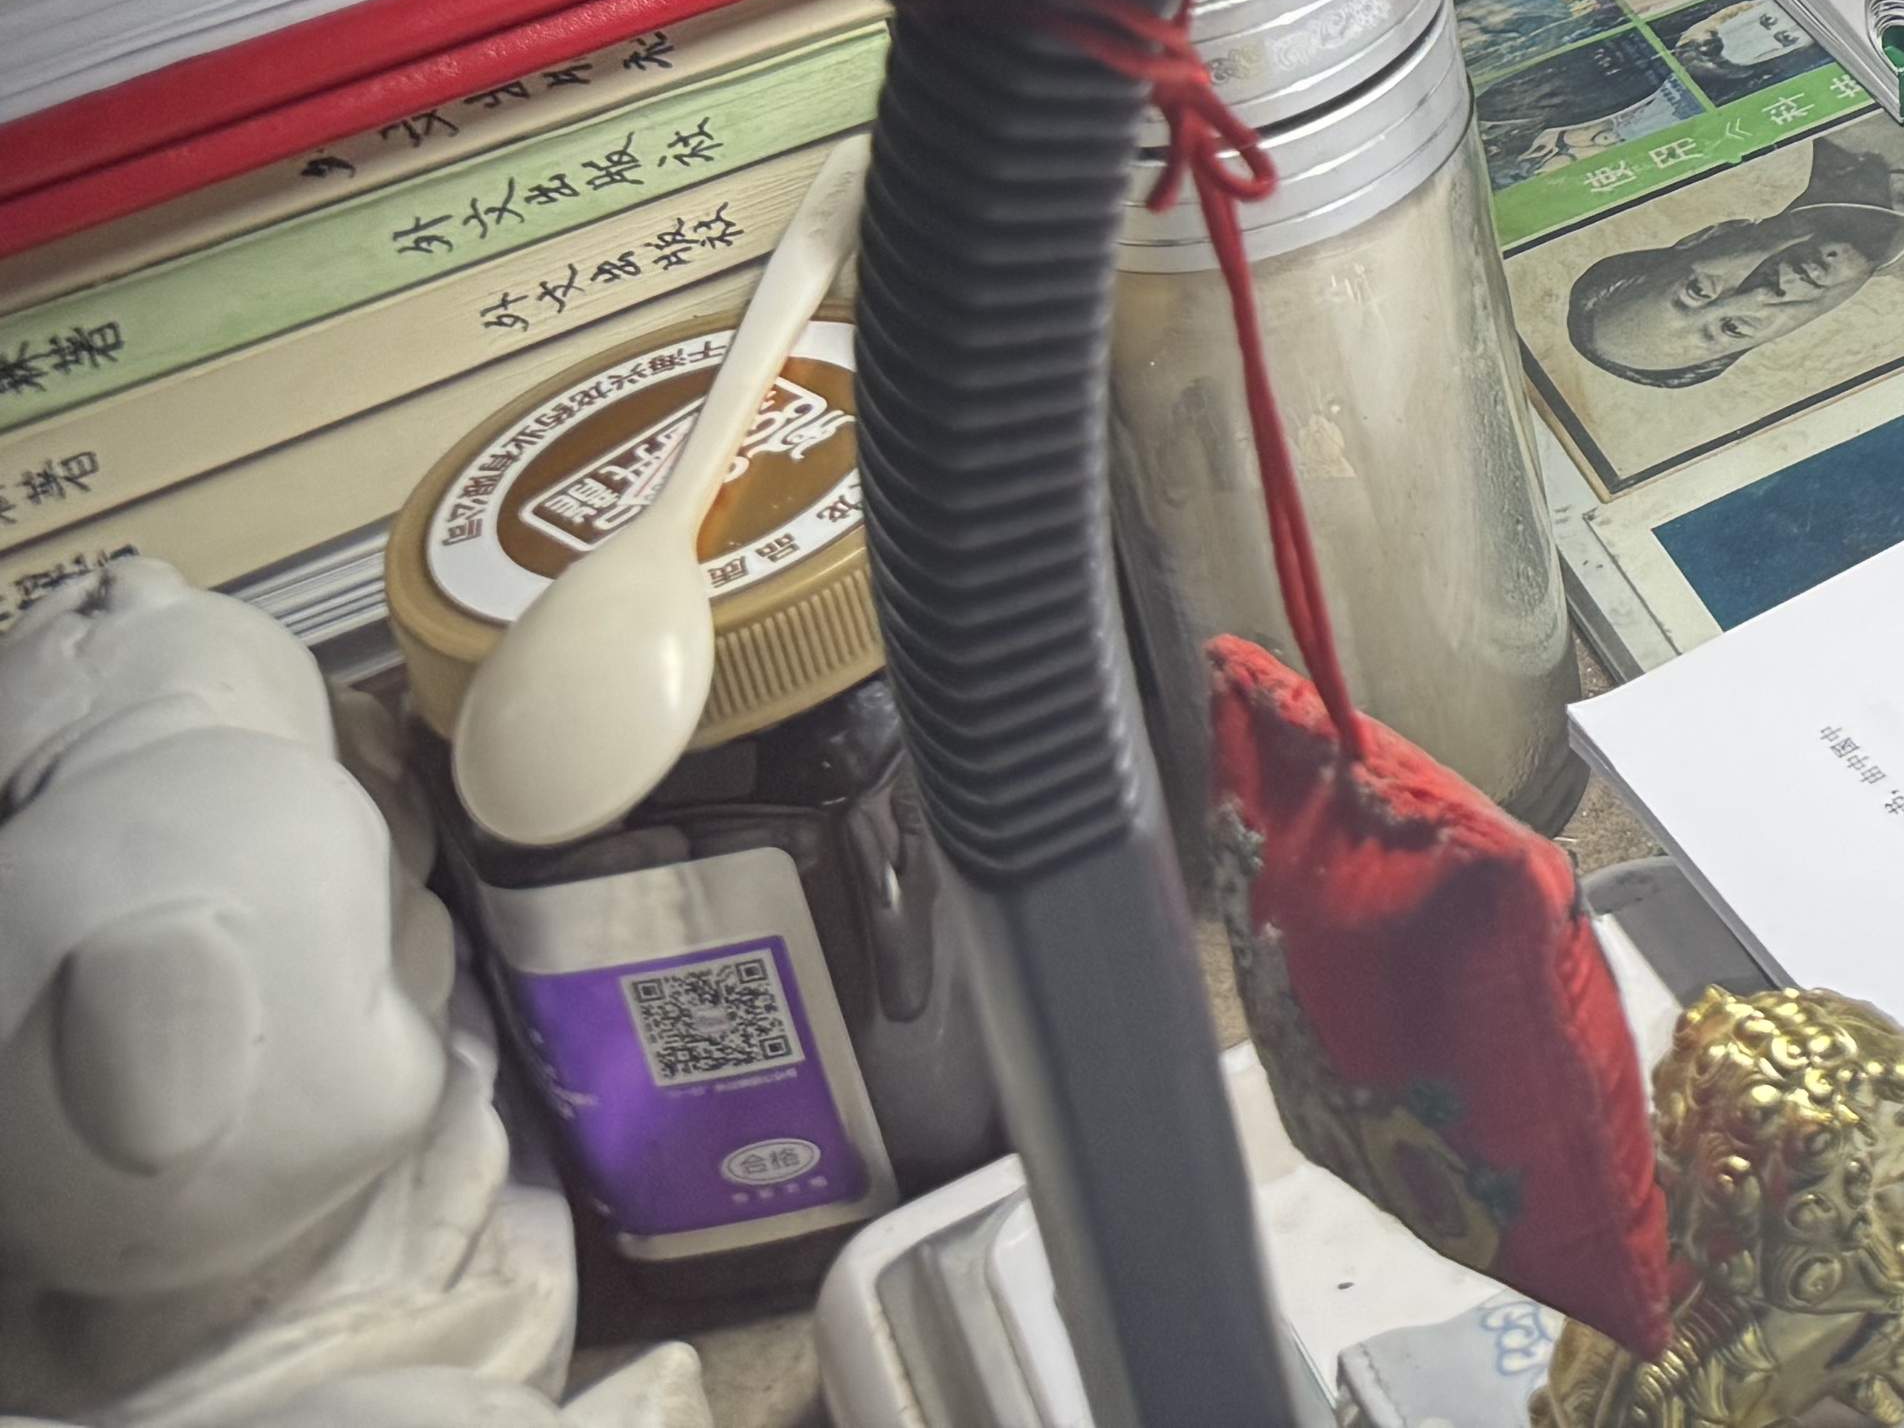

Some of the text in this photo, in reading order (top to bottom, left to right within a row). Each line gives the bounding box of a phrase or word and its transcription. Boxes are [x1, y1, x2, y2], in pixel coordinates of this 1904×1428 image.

[392, 117, 724, 256] 外文出版社
[481, 202, 745, 331] 外文出版社
[738, 1144, 802, 1176] 合格
